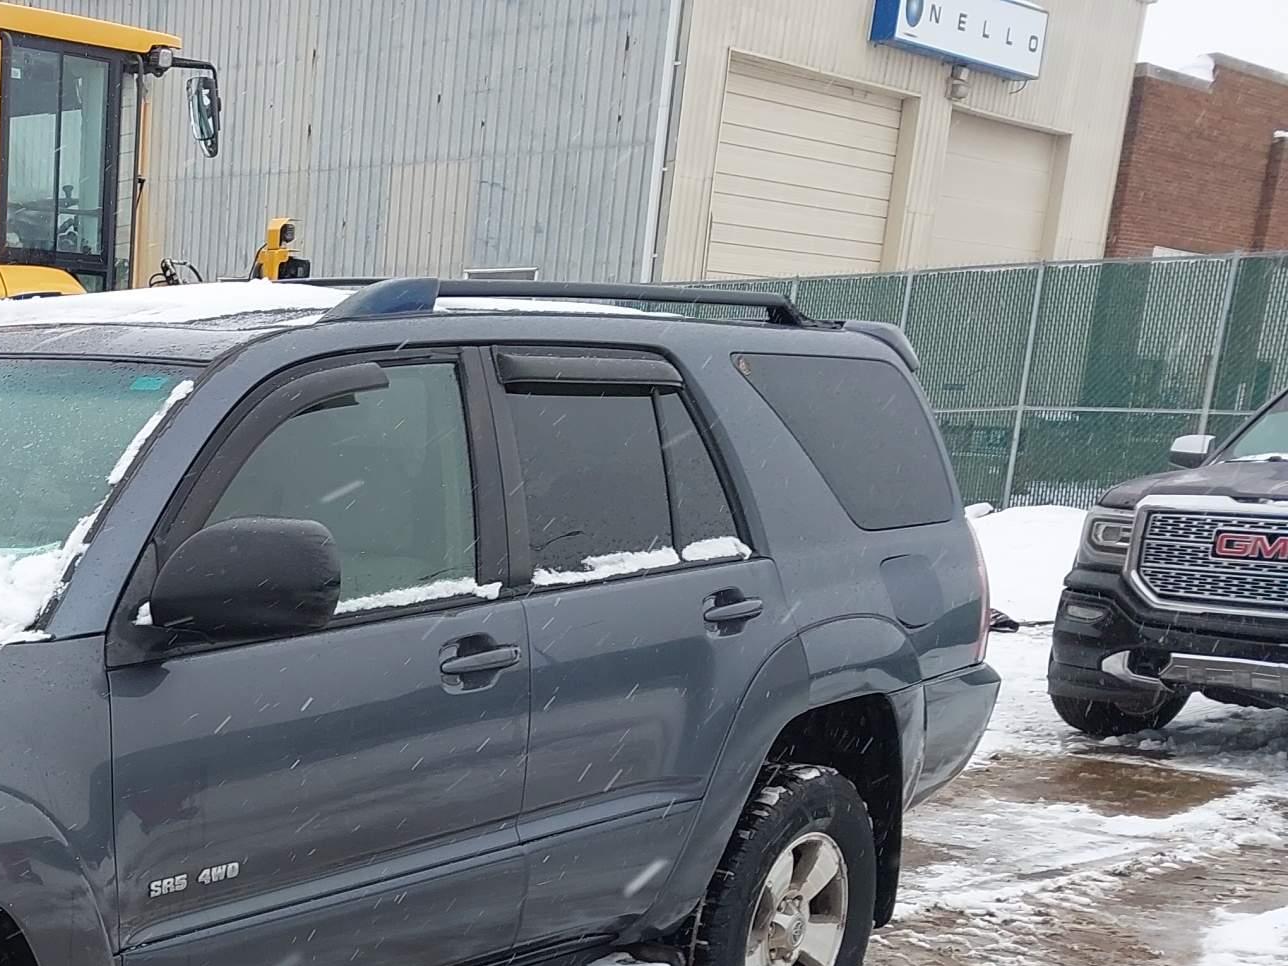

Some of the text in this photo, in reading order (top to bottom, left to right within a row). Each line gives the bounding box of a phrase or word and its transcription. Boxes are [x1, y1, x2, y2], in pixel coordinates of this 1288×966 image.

[929, 4, 1039, 53] NELLO
[1215, 532, 1288, 560] GM
[149, 862, 240, 898] SR5 4WD
